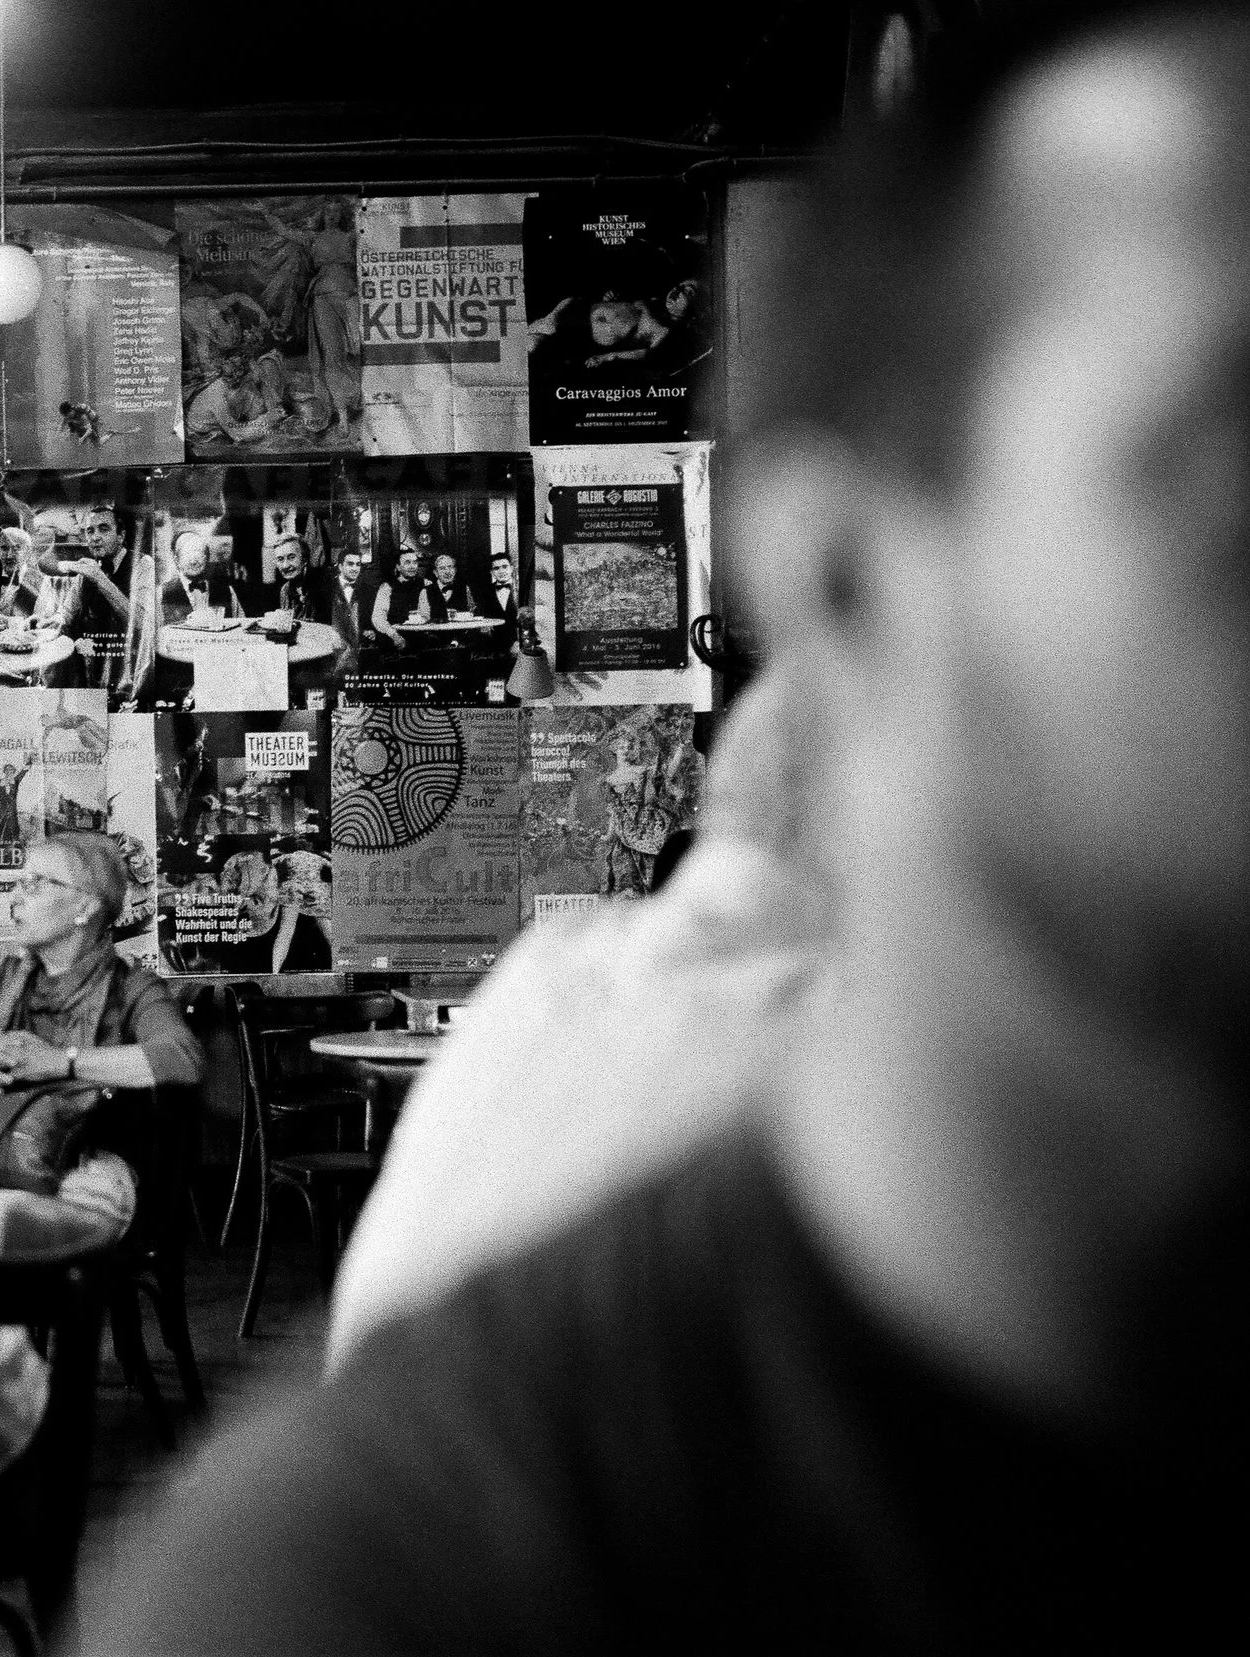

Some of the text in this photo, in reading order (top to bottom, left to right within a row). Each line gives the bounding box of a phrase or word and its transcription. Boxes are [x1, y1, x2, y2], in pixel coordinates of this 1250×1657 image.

[599, 214, 629, 223] KUNST
[582, 222, 646, 231] HISTORISCHES
[595, 230, 634, 238] MUSEUM
[602, 237, 626, 245] WIEN
[361, 249, 494, 264] ÖSTERREICHISCHE
[361, 261, 504, 277] NATIONALSTIFTUNG
[361, 276, 518, 299] GEGENWART
[362, 299, 516, 341] KUNST
[555, 385, 688, 402] Caravaggios Amor
[563, 472, 676, 484] INTERNATIONA
[583, 520, 619, 530] CHARLES
[459, 710, 515, 721] Livemusik
[248, 736, 304, 751] THEATER
[547, 731, 597, 746] Spettacolo
[570, 758, 586, 769] des
[470, 765, 504, 776] Kunst
[464, 795, 496, 808] Tanz
[338, 846, 513, 893] afriCult
[191, 892, 242, 905] Five Truths
[175, 906, 239, 919] Shakespeares
[175, 918, 253, 930] Wahrheit und die
[176, 930, 248, 945] Kunst der Regie
